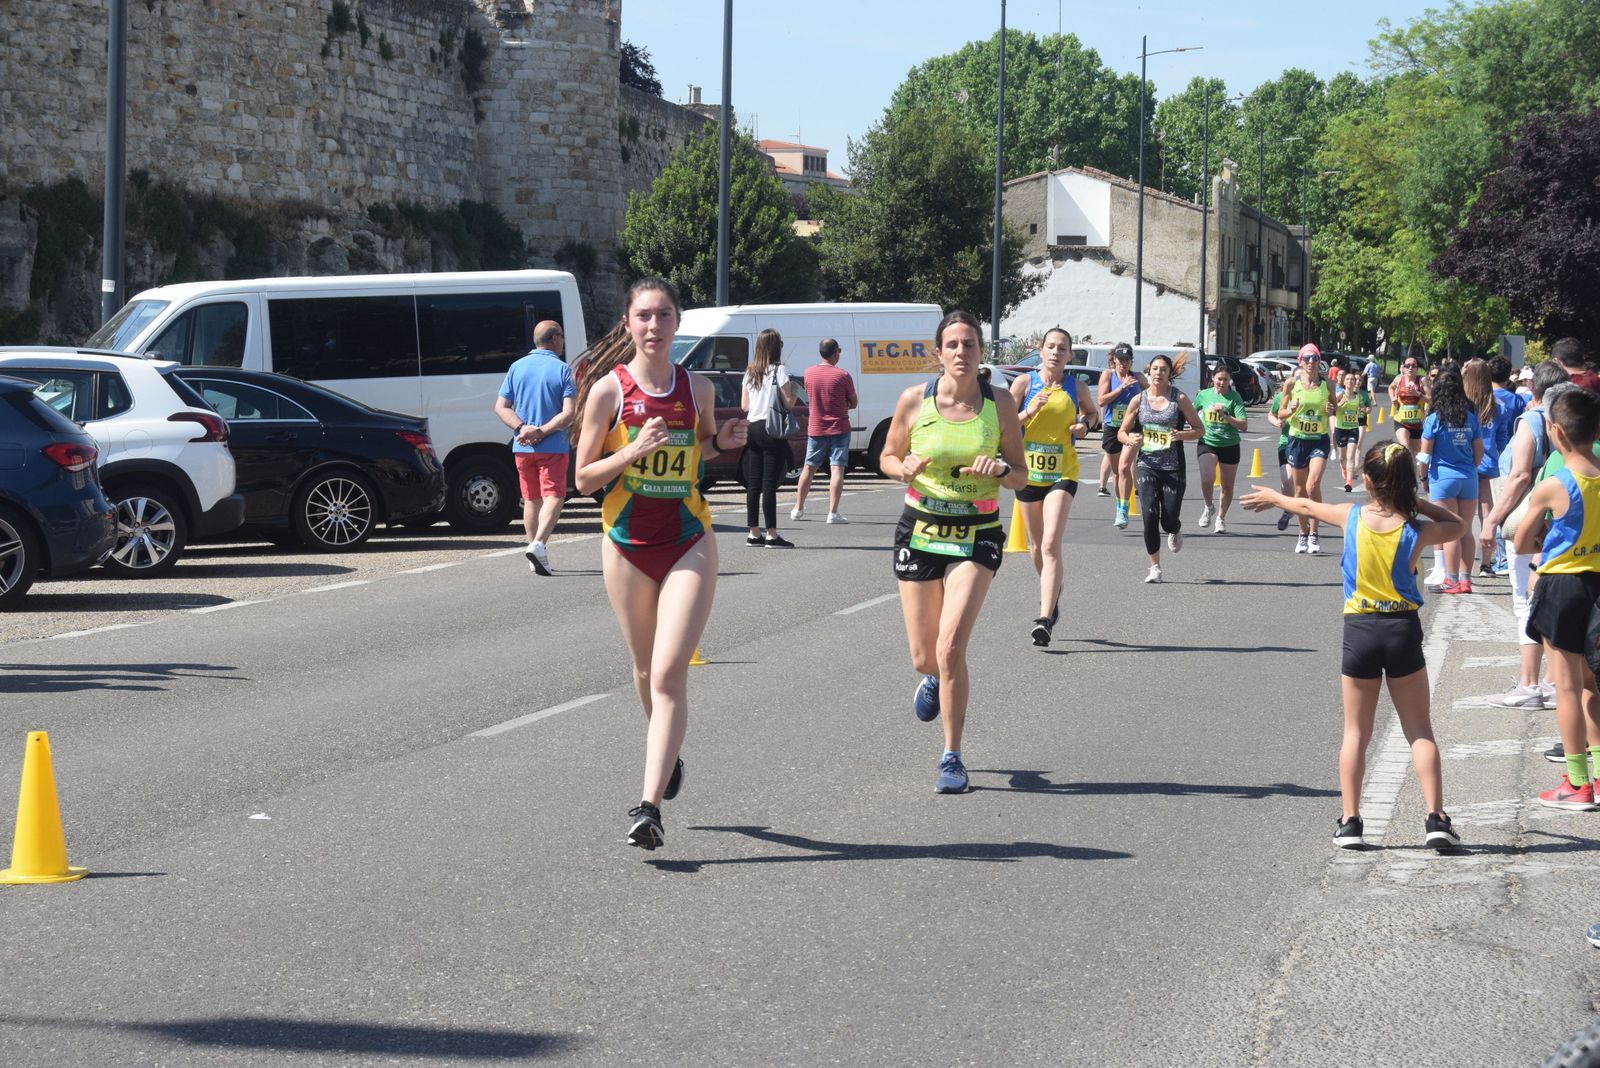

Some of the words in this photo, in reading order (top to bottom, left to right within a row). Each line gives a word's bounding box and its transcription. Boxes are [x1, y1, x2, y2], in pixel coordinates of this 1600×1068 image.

[1404, 411, 1419, 419] 107
[1299, 421, 1319, 433] 103
[1147, 431, 1168, 446] 185
[632, 451, 685, 476] 404
[1028, 454, 1057, 471] 199
[642, 484, 662, 493] CAJA
[662, 485, 688, 493] RURAL
[939, 482, 977, 493] Adarsa
